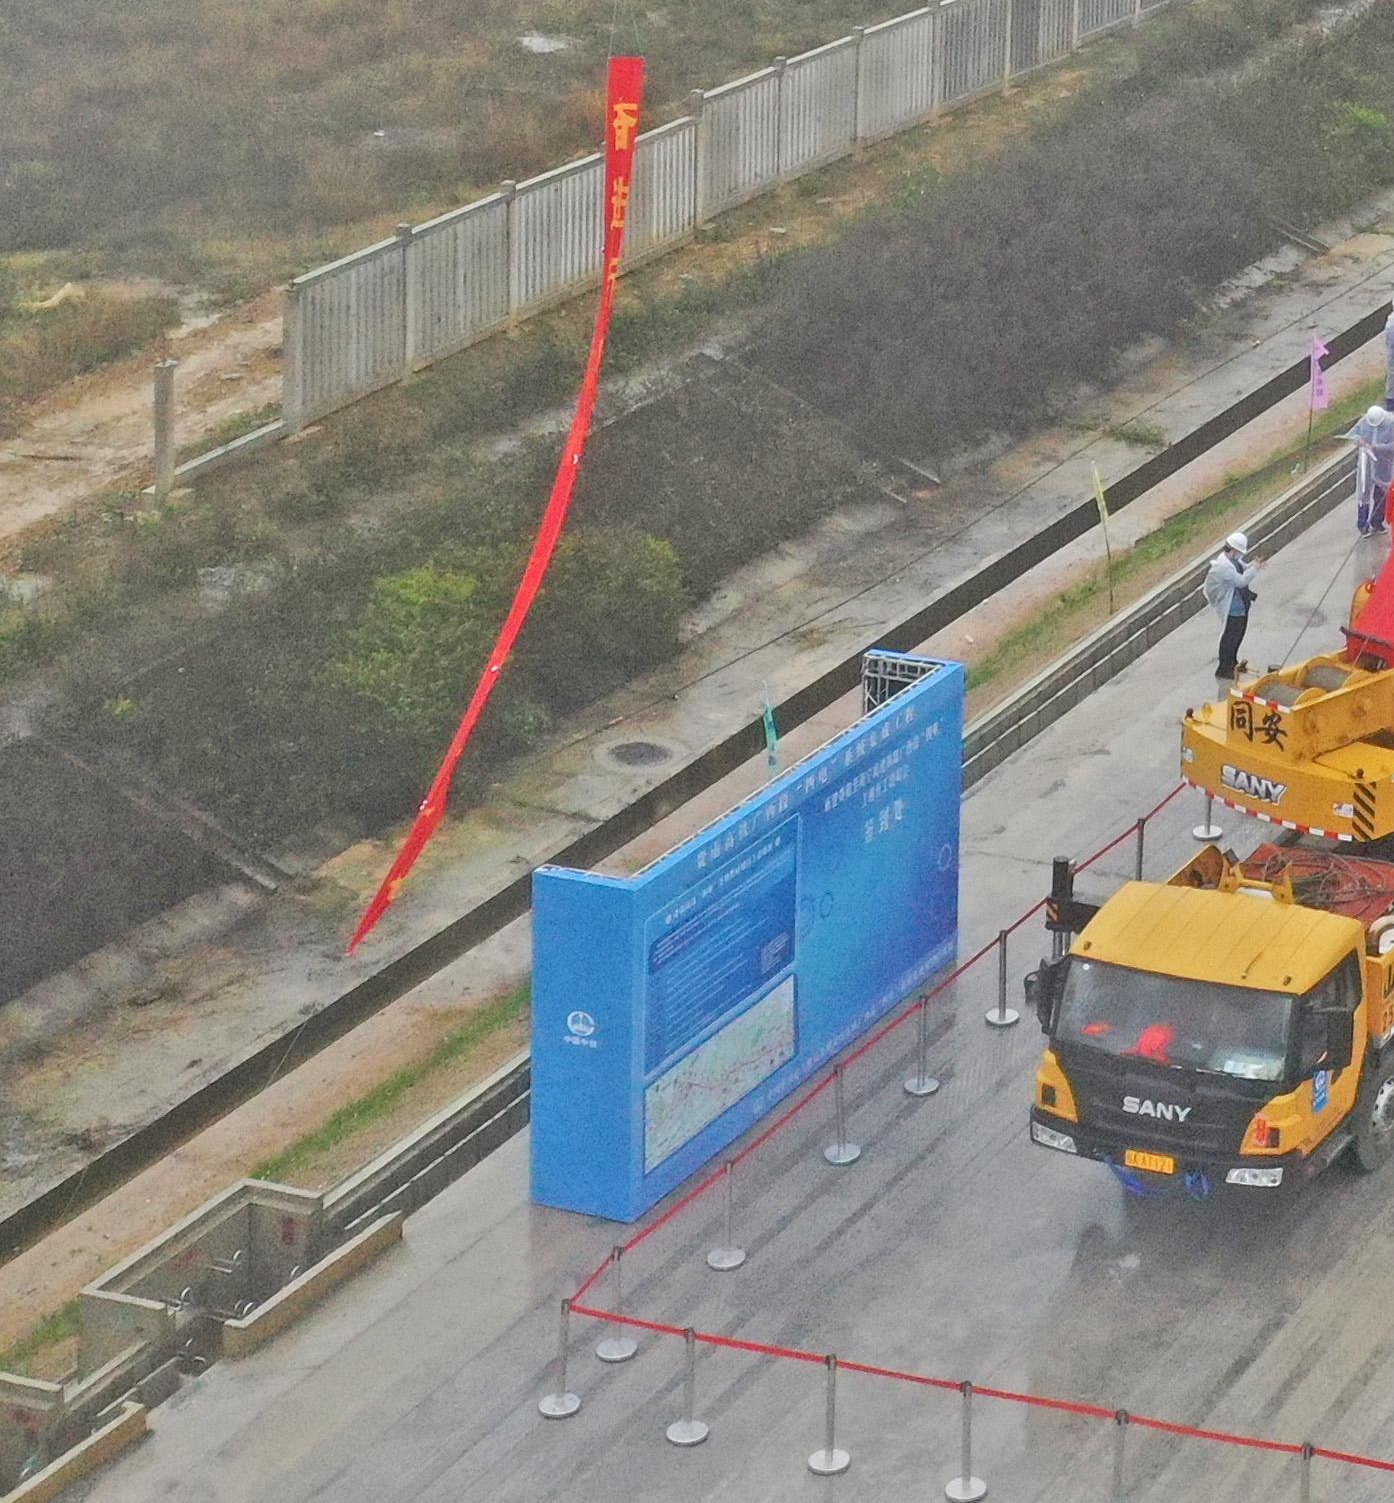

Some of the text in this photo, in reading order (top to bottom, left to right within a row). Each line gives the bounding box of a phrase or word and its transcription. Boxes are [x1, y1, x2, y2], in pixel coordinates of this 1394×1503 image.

[1230, 700, 1288, 752] 同安
[1220, 764, 1288, 806] SANY
[1122, 1096, 1193, 1123] SANY
